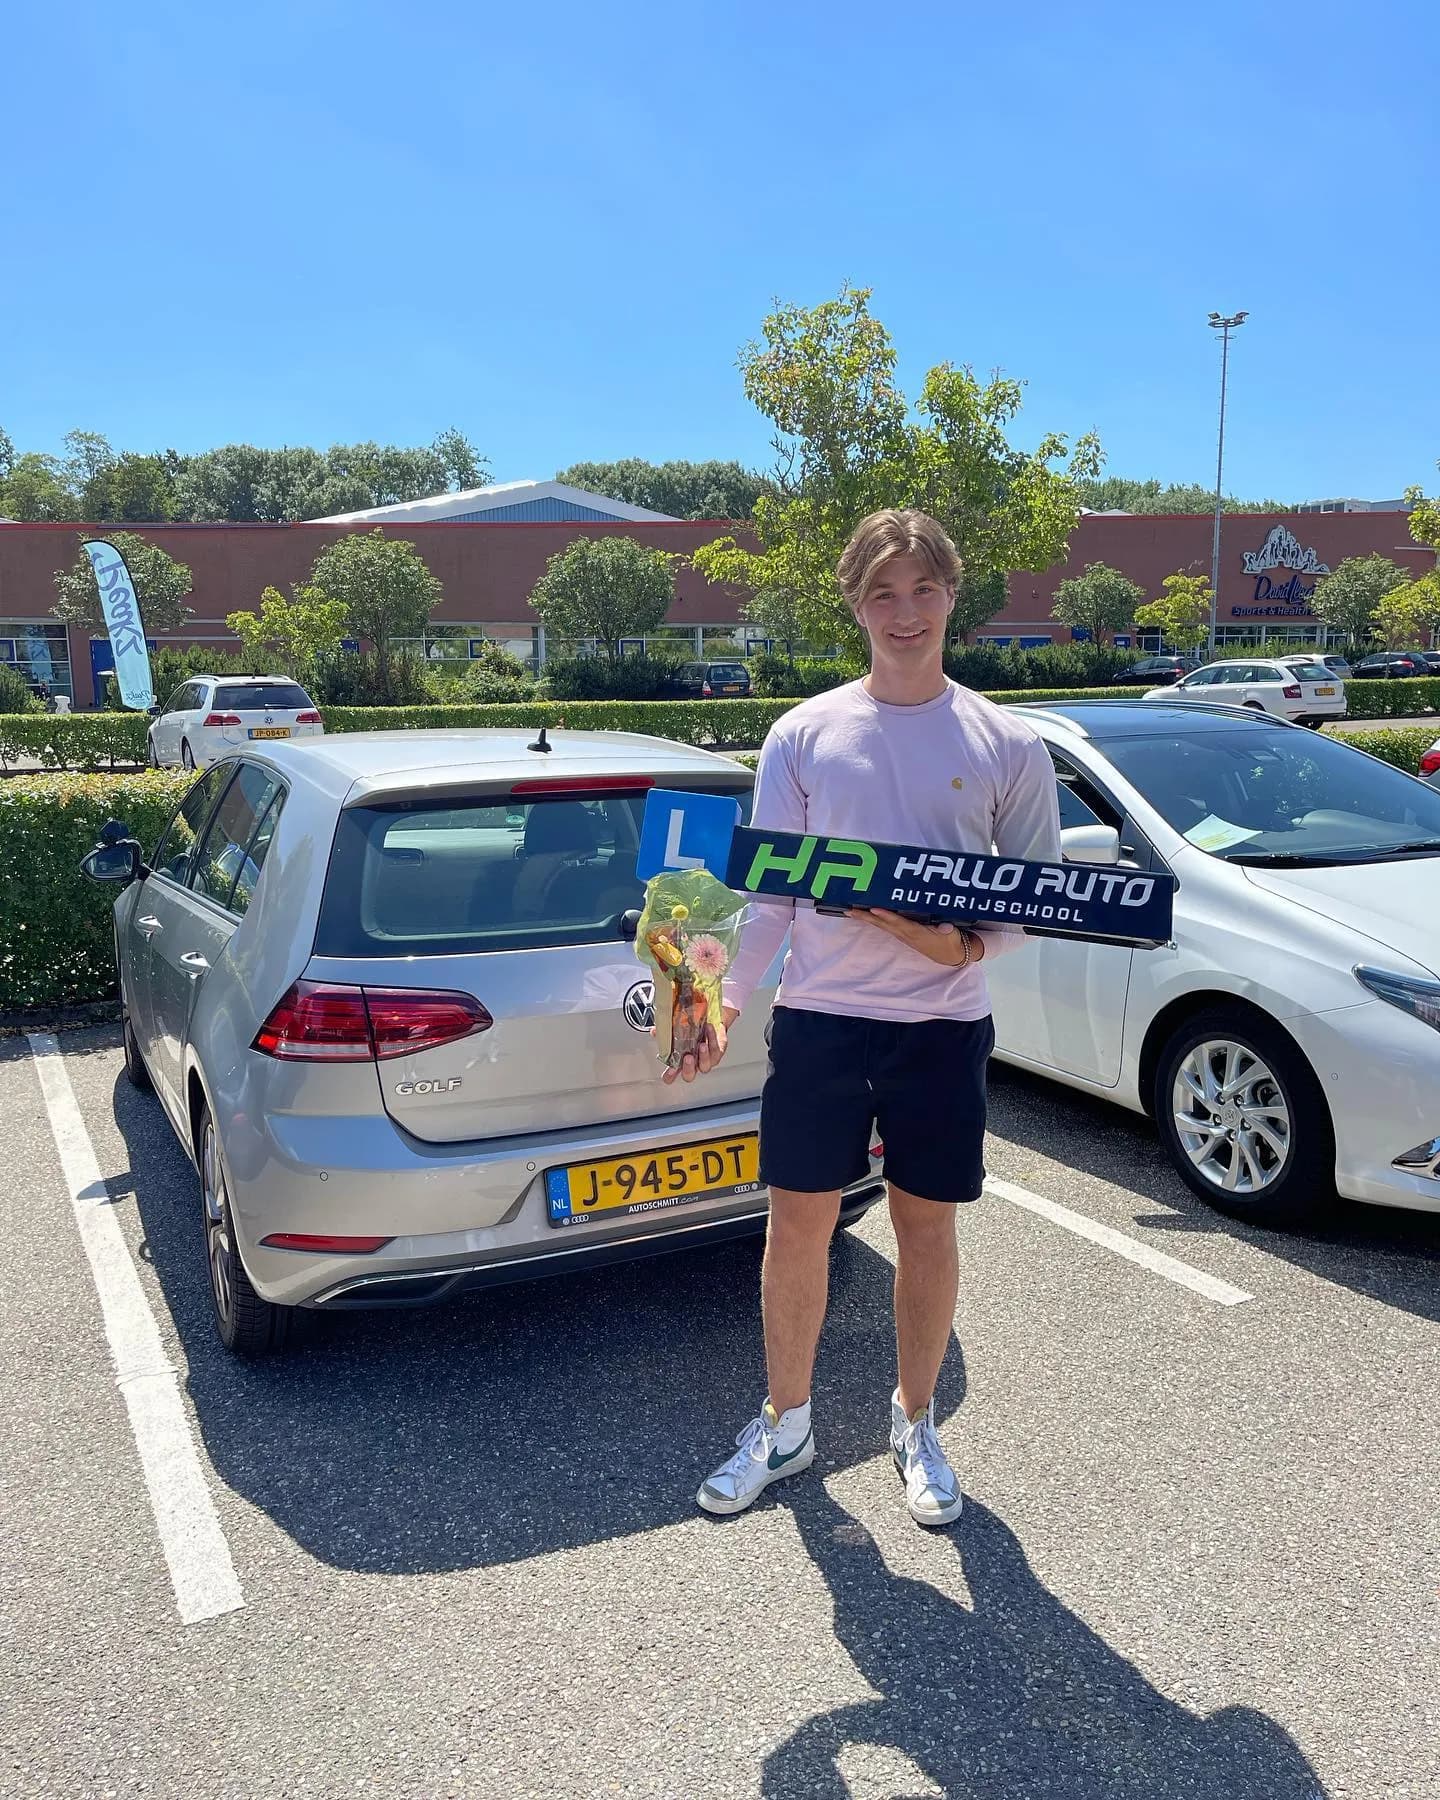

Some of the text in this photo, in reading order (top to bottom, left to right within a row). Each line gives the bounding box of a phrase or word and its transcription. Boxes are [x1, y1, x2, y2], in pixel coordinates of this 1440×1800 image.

[1232, 606, 1267, 617] Sports
[1268, 607, 1276, 616] &
[663, 808, 705, 870] L
[744, 835, 878, 899] HA
[893, 853, 1155, 908] HALLO AUTO
[891, 888, 1084, 922] AUTORIJSCHOOL
[395, 1077, 462, 1096] GOLF
[582, 1144, 745, 1206] J-945-DT
[552, 1198, 568, 1211] NL
